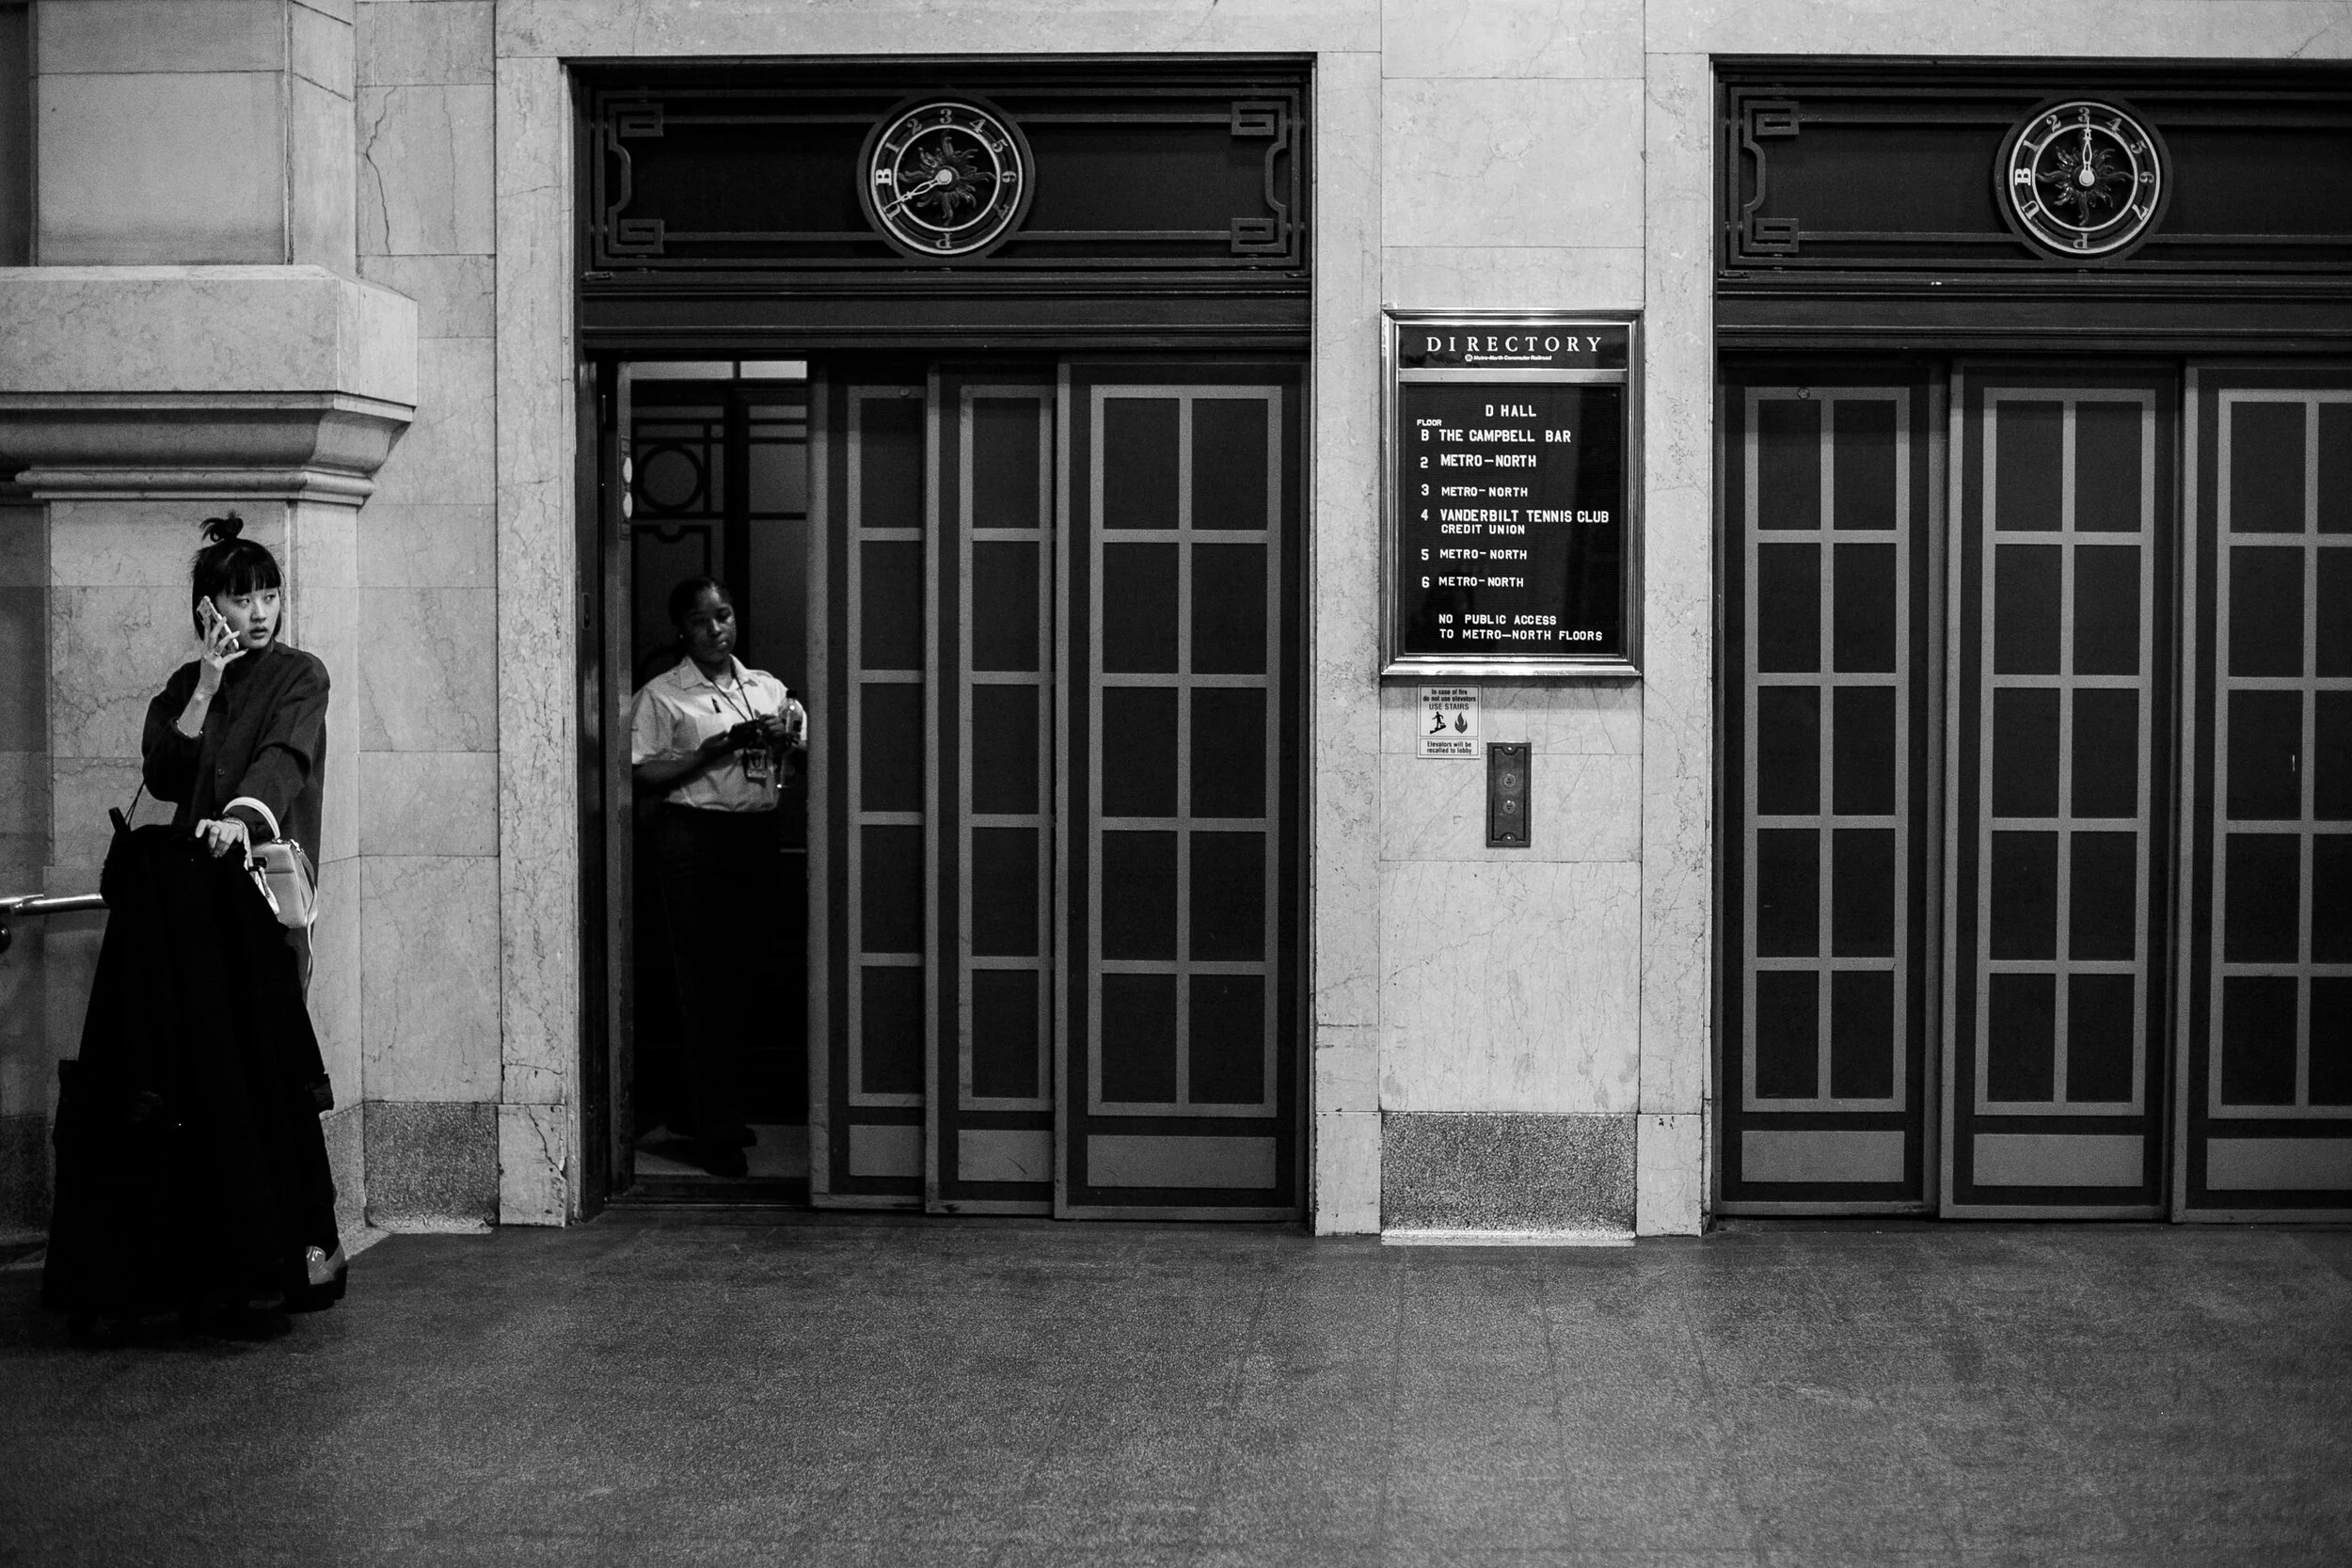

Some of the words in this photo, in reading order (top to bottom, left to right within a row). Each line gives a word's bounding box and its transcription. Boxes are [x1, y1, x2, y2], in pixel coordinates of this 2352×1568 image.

[940, 109, 952, 123] 3
[2078, 107, 2090, 122] 3
[907, 119, 922, 135] 2
[970, 119, 985, 134] 4
[2046, 115, 2061, 131] 2
[2106, 118, 2122, 131] 4
[992, 138, 1009, 153] 5
[2131, 142, 2148, 153] 5
[876, 168, 892, 185] B
[2014, 167, 2031, 185] B
[2021, 200, 2040, 220] U
[2132, 204, 2149, 220] 7
[935, 233, 952, 248] P
[2074, 233, 2089, 248] P
[1426, 336, 1601, 352] DIRECTORY
[1486, 404, 1493, 417] D
[1502, 404, 1536, 417] HALL
[1422, 429, 1429, 441] B
[1439, 429, 1463, 441] THE
[1470, 430, 1534, 442] CAMPBELL
[1546, 430, 1570, 442] BAR
[1421, 457, 1428, 467] 2
[1422, 483, 1429, 496] 3
[1422, 509, 1428, 520] 4
[1440, 509, 1518, 522] VANDERBILT
[1526, 510, 1572, 522] TENNIS
[1578, 511, 1609, 522] CLUB
[1441, 524, 1482, 533] CREDIT
[1489, 525, 1524, 534] UNION
[1422, 549, 1428, 560] 5
[1422, 577, 1429, 588] 6
[1439, 614, 1453, 624] NO
[1465, 614, 1506, 624] PUBLIC
[1514, 615, 1556, 625] ACCESS
[1440, 629, 1454, 638] TO
[1463, 629, 1550, 640] METRO-NORTH
[1559, 631, 1602, 641] FLOORS
